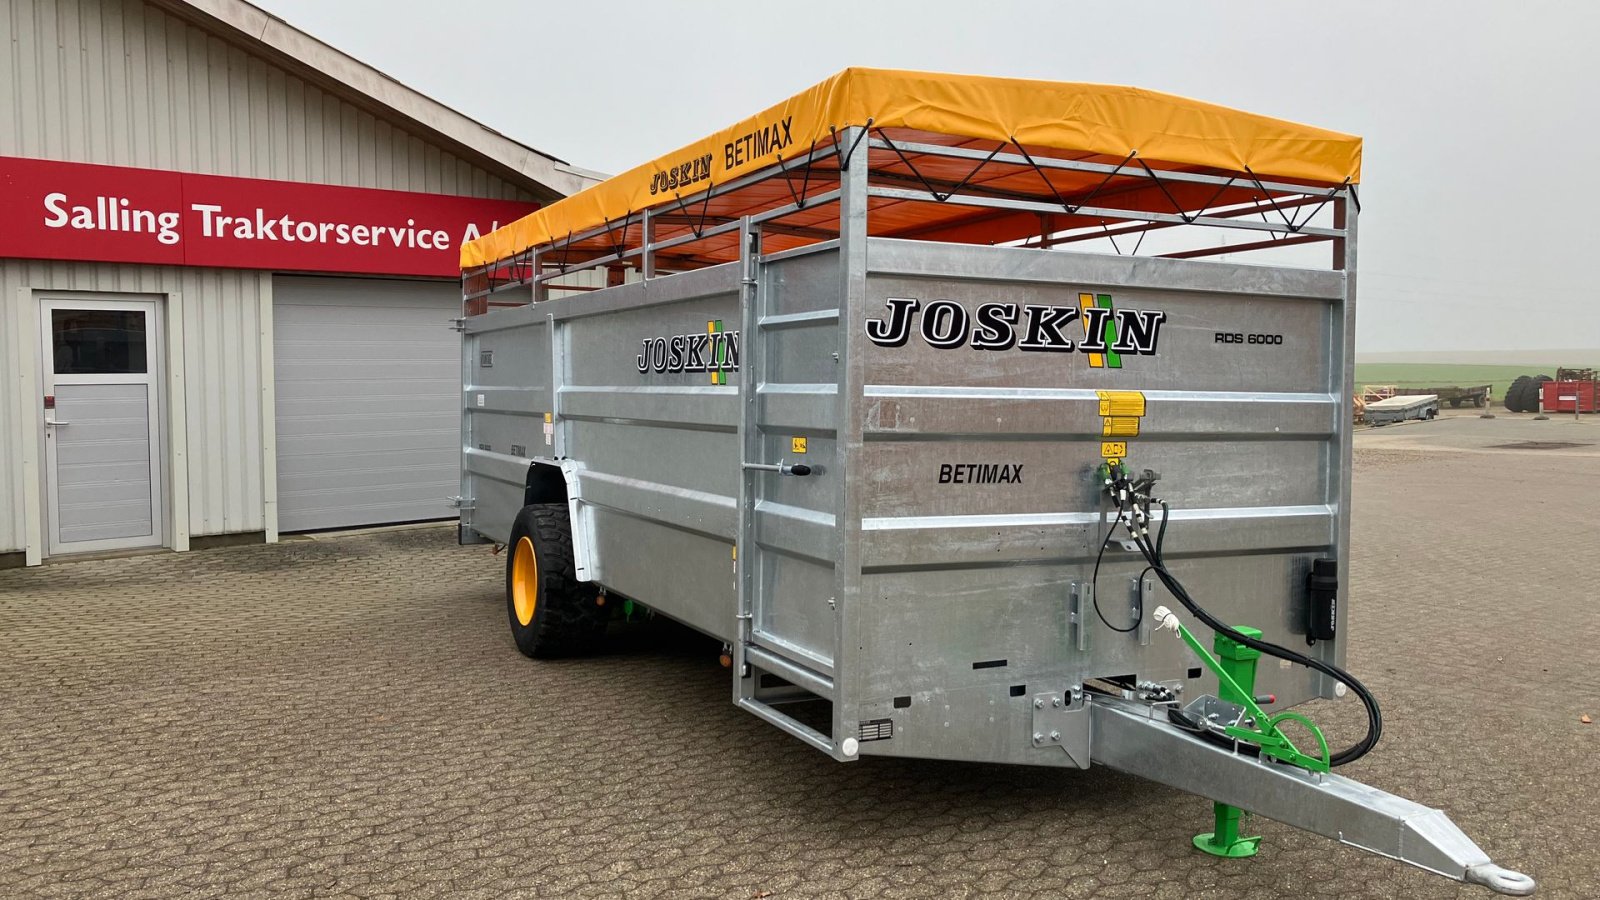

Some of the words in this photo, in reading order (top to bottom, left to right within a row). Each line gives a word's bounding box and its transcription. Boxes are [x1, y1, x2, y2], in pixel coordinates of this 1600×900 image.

[650, 152, 713, 195] JOSKIN
[724, 116, 793, 171] BETIMAX
[43, 192, 180, 244] Salling
[191, 203, 450, 250] Traktorservice
[865, 297, 1167, 355] JOSKIN
[1214, 332, 1245, 345] RDS
[1247, 333, 1283, 346] 6000
[637, 330, 740, 374] JOSKIN
[938, 463, 1024, 484] BETIMAX
